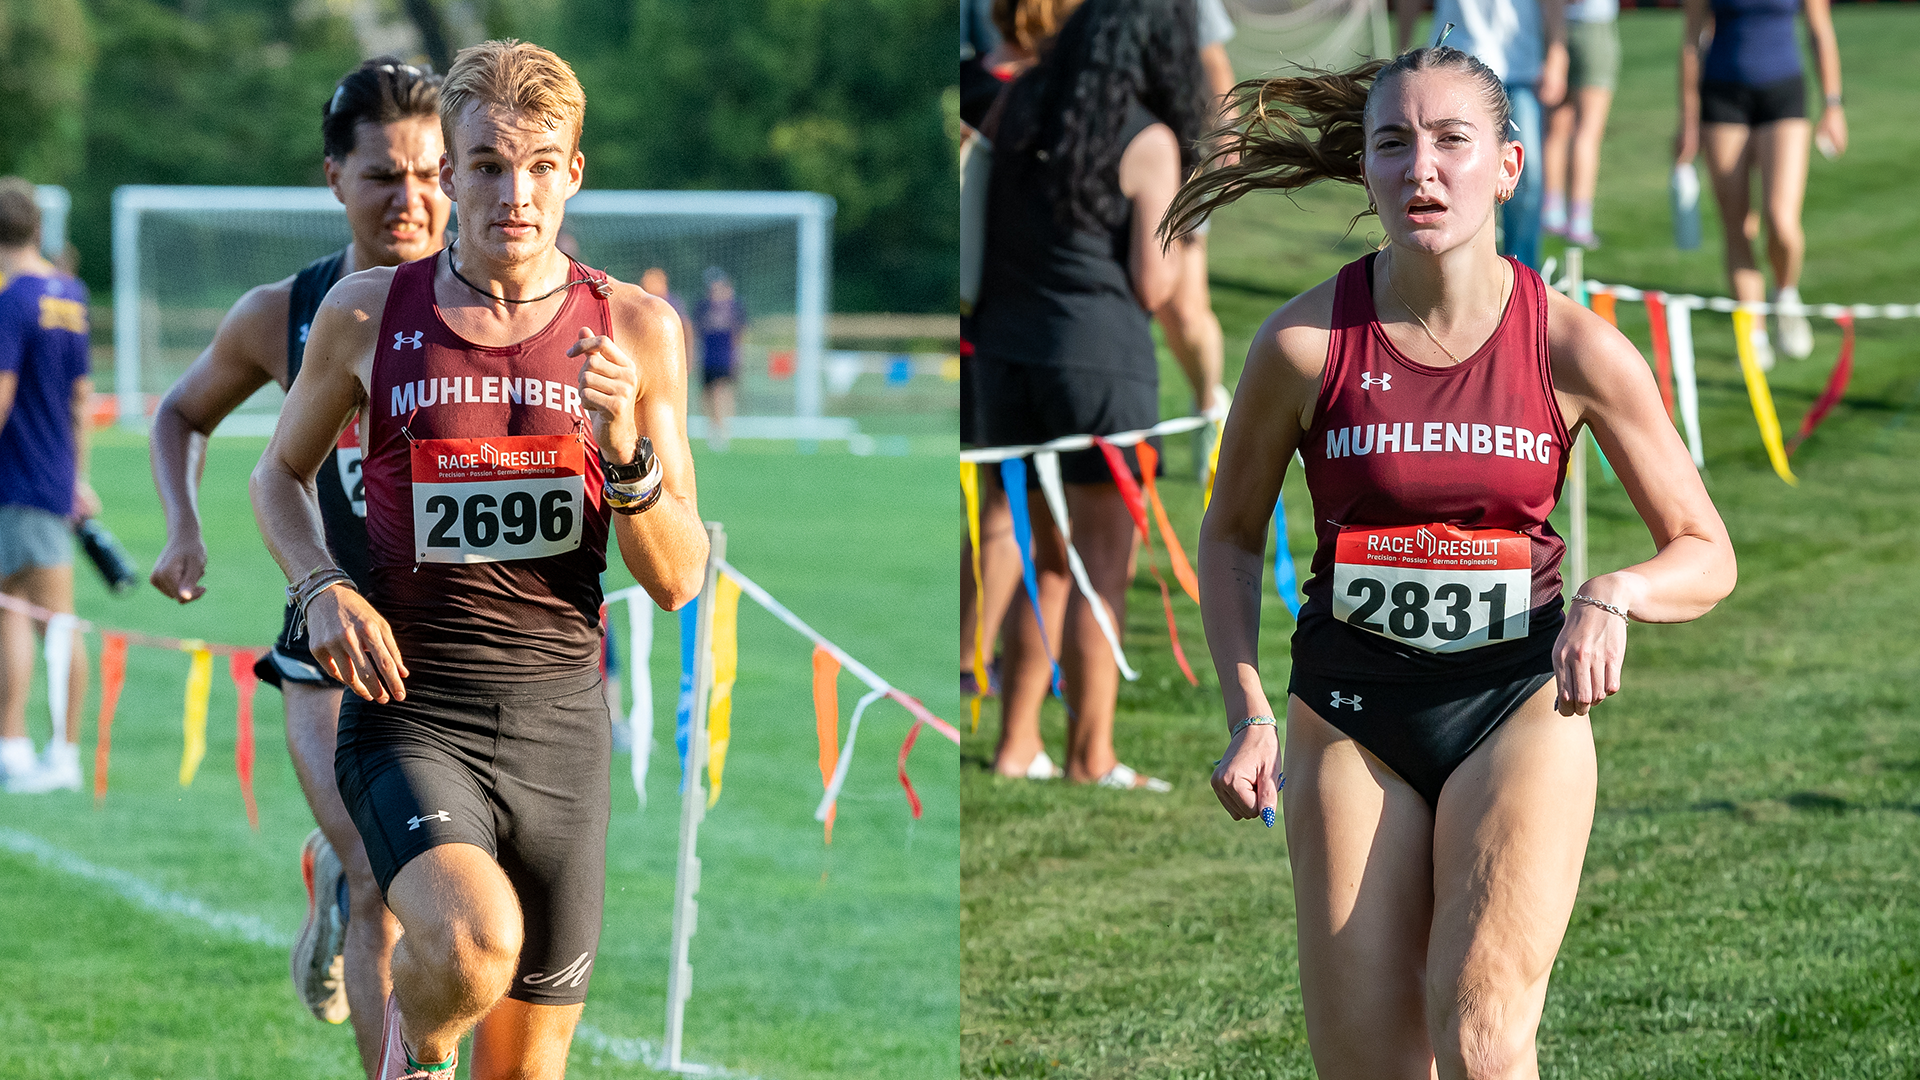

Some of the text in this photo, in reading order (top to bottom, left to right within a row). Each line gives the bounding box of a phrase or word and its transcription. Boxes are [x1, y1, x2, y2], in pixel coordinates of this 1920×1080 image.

[391, 376, 592, 420] MUHLENBER
[1326, 422, 1552, 464] MUHLENBERG
[438, 451, 558, 469] RACE RESULT
[470, 469, 493, 477] Passion
[497, 468, 520, 476] German
[521, 466, 556, 475] Engineering
[426, 489, 573, 548] 2696
[1367, 534, 1500, 556] RACE RESULT
[1367, 553, 1397, 562] Precision
[1402, 556, 1428, 564] Passion
[1459, 558, 1498, 566] Engineering
[1346, 577, 1507, 641] 2831
